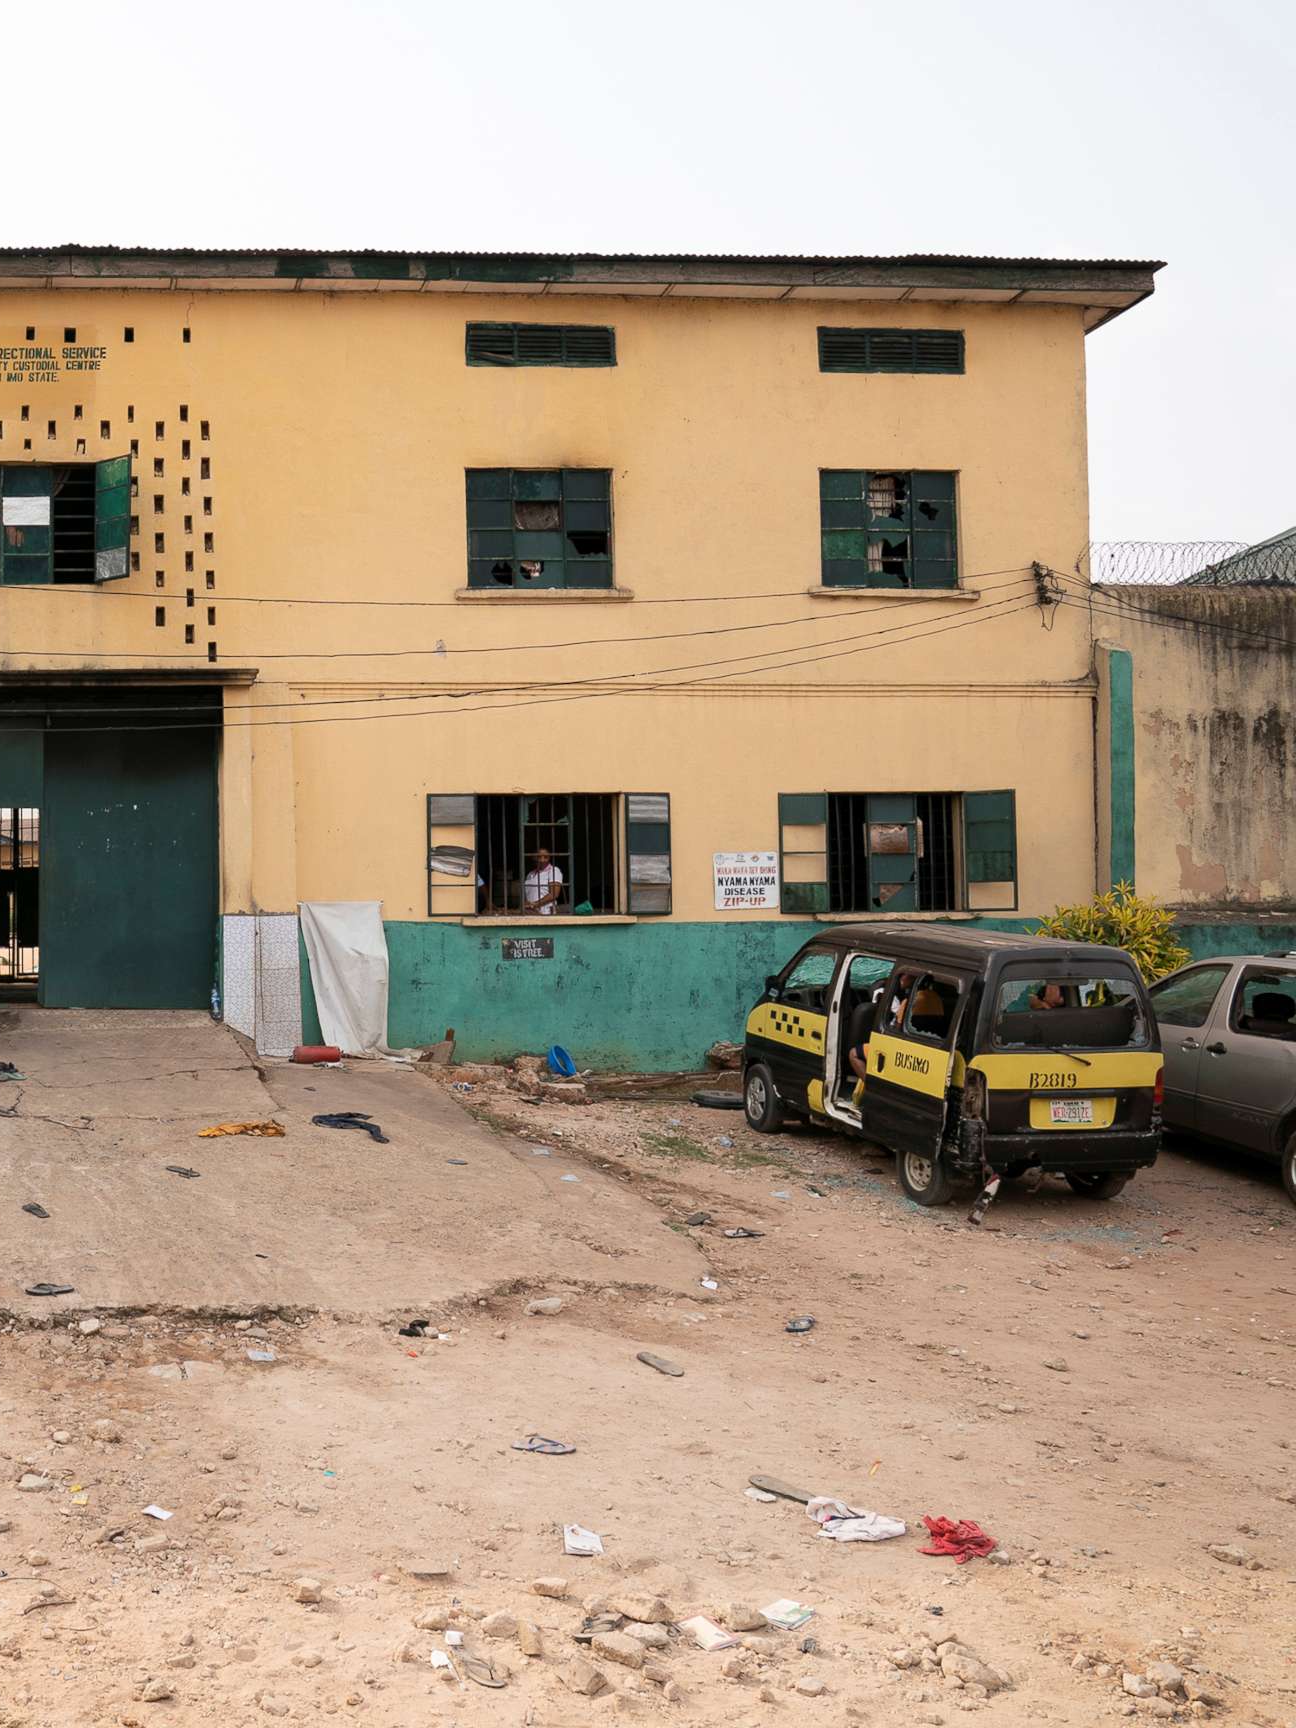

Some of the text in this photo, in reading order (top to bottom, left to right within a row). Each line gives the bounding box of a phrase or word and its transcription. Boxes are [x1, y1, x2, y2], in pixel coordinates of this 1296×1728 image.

[62, 347, 106, 359] SERVICE
[13, 360, 60, 371] CUSTODIAL
[66, 360, 101, 370] CENTRE
[6, 372, 23, 382] IMO
[717, 876, 776, 886] NYAMA NYAMA
[724, 887, 765, 896] DISEASE
[723, 896, 766, 907] ZIP-UP
[514, 939, 536, 949] VISIT
[1029, 1072, 1077, 1088] B2819
